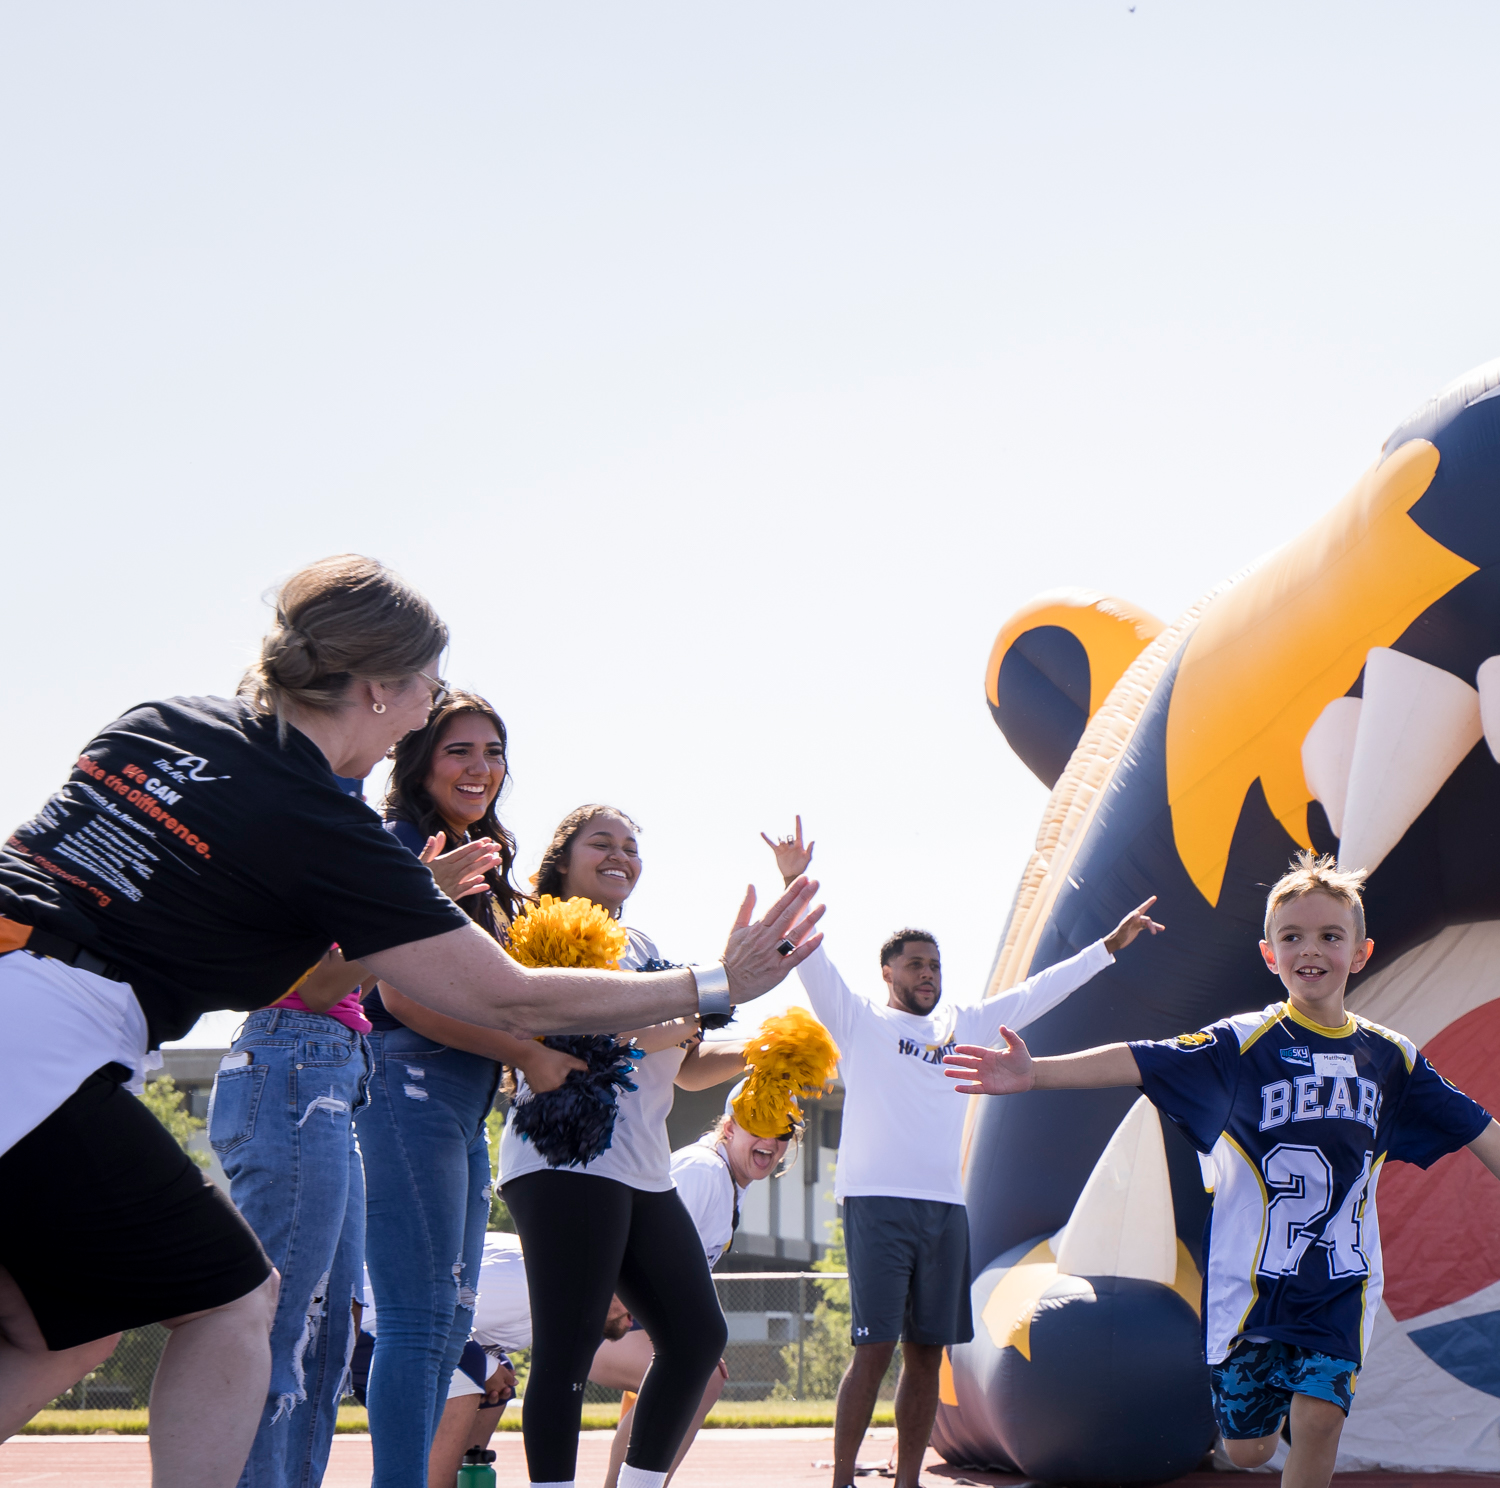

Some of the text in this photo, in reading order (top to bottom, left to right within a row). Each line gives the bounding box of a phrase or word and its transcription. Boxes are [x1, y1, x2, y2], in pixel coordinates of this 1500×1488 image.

[121, 764, 183, 805] We CAN
[153, 758, 189, 784] The Arc
[104, 775, 130, 795] the
[126, 789, 211, 860] Difference.
[1292, 1048, 1308, 1059] SKY
[1258, 1073, 1384, 1139] BEAR
[1255, 1143, 1373, 1279] 24
